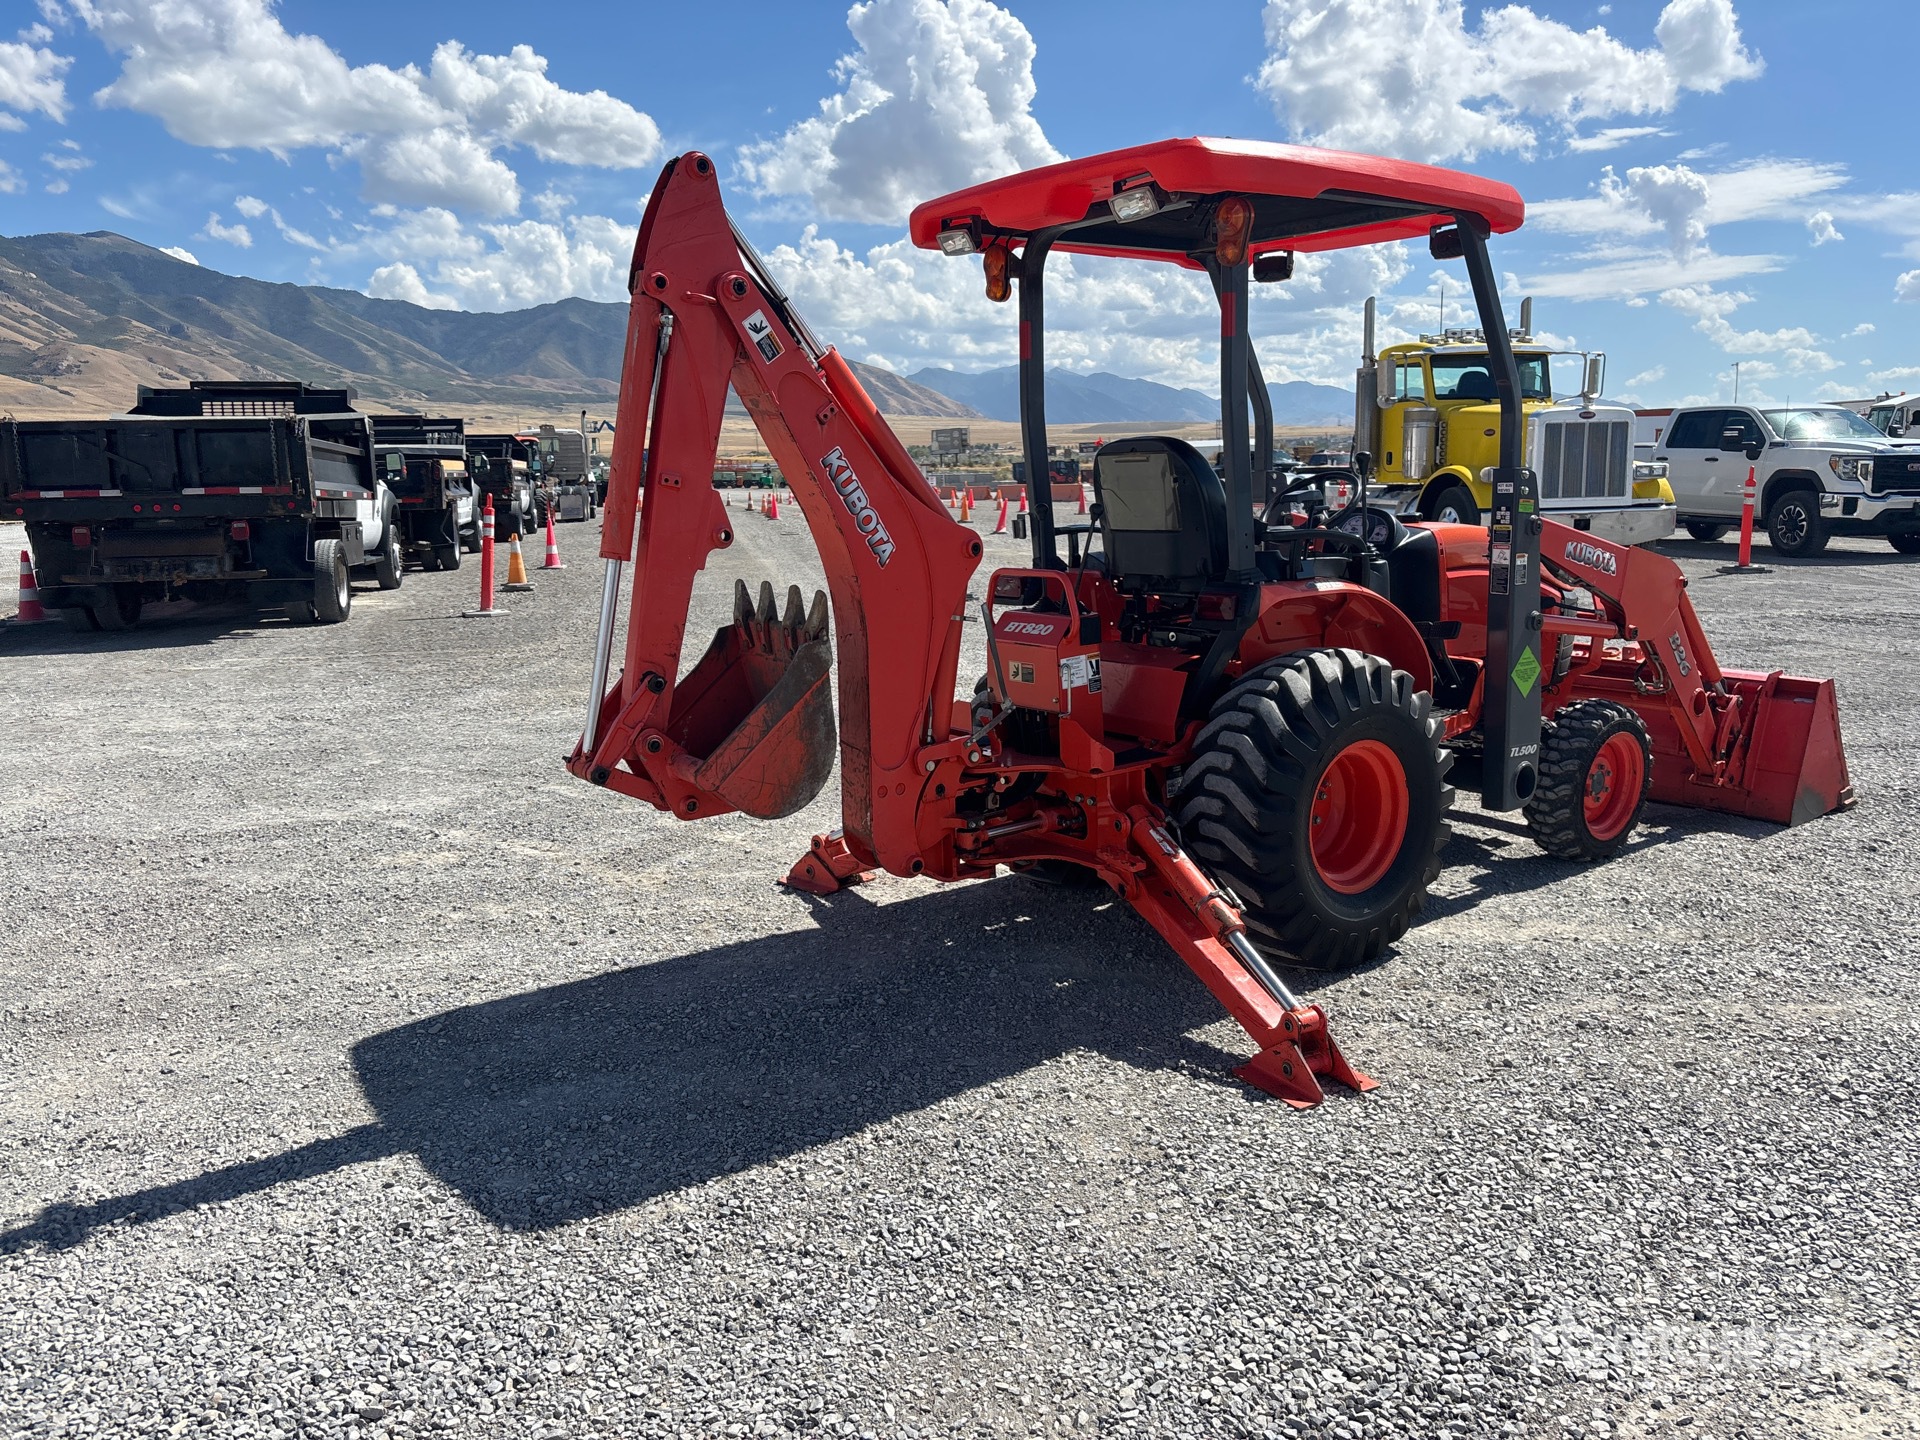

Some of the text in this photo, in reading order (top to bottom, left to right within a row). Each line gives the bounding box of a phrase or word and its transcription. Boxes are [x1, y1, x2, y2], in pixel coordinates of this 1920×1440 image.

[821, 447, 895, 568] KUBOTA
[1566, 542, 1616, 575] KUBOTA
[1003, 621, 1055, 636] BT820
[1669, 632, 1692, 676] B26
[1510, 744, 1537, 757] TL500
